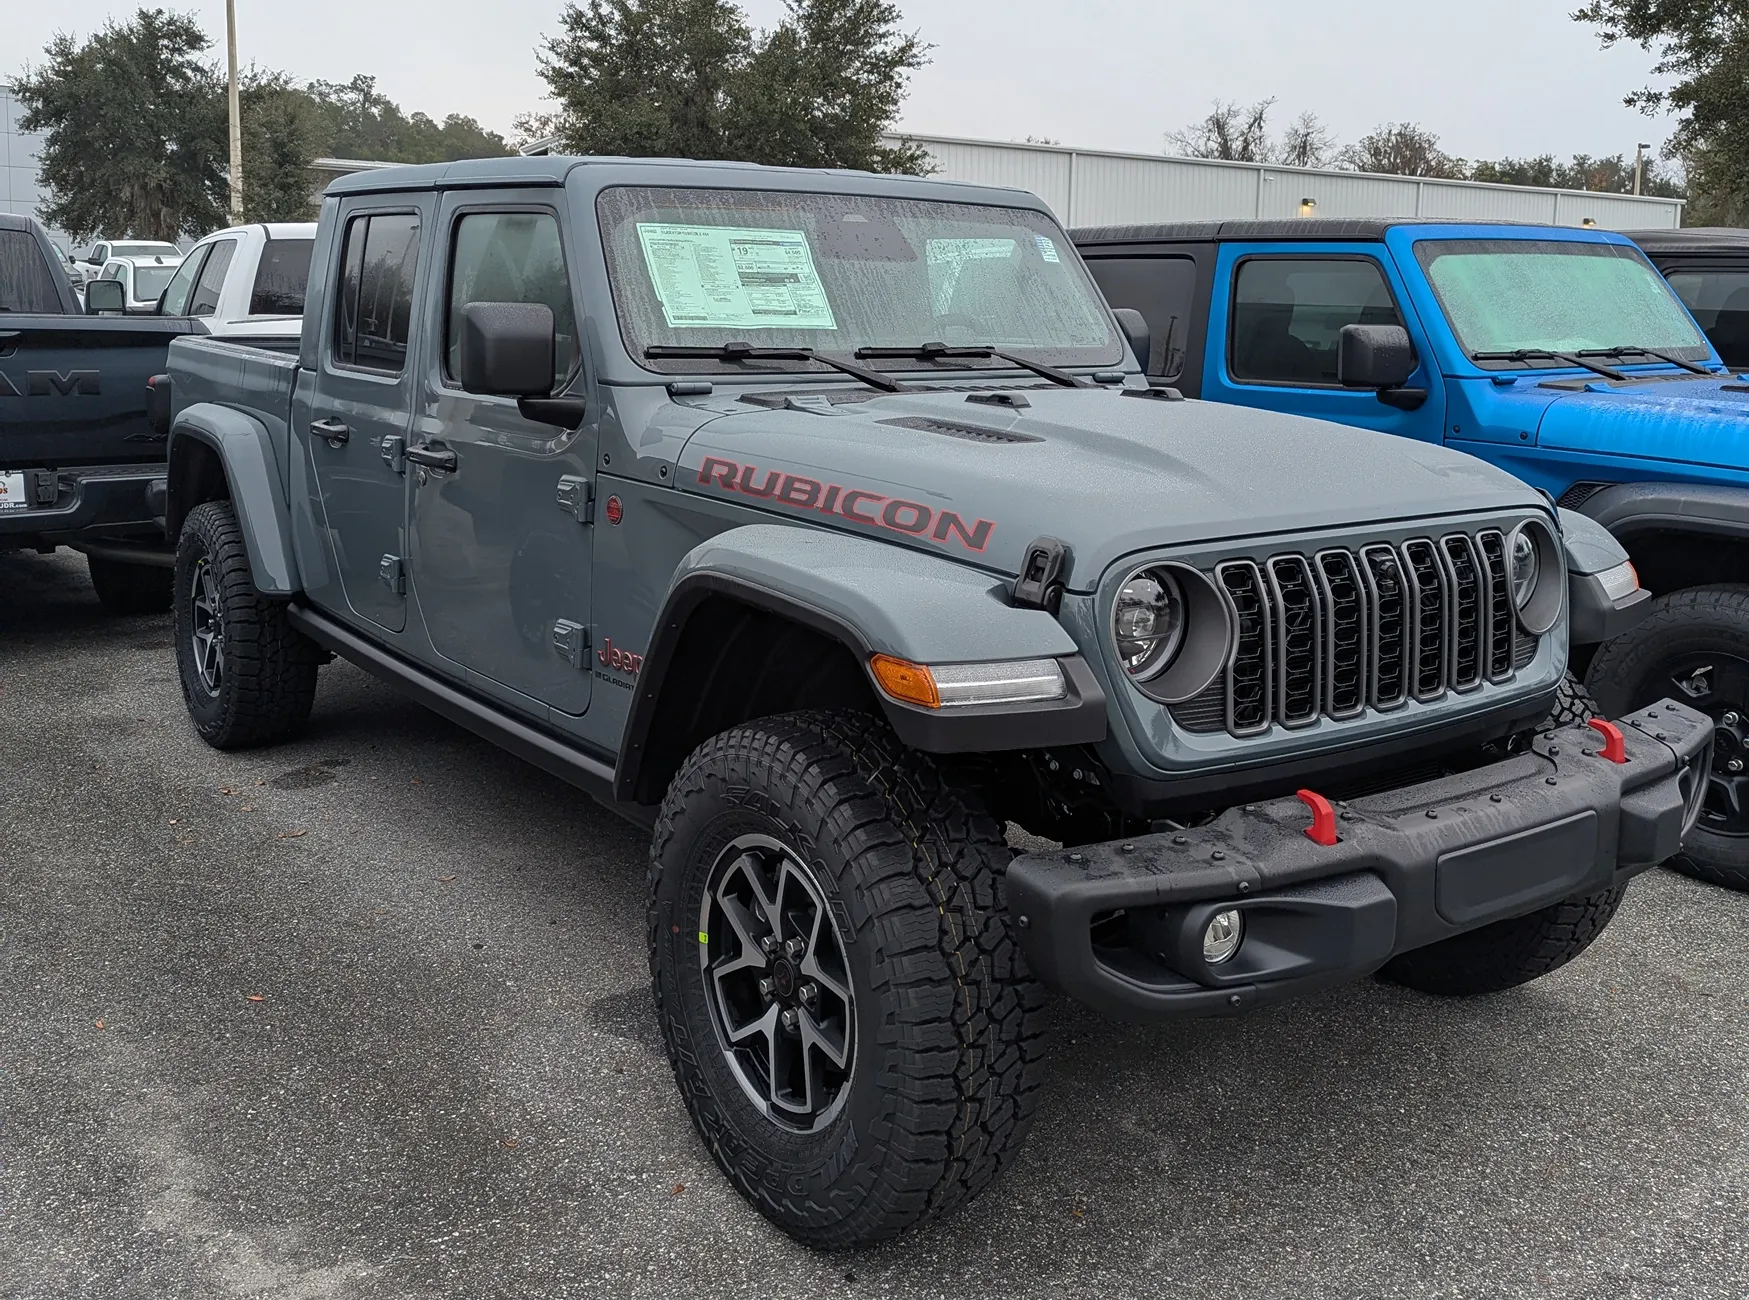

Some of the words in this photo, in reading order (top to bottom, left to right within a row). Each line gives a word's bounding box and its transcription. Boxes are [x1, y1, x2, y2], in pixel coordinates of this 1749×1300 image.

[737, 246, 749, 256] 19
[698, 456, 997, 553] RUBICON
[719, 785, 858, 943] FALKEN
